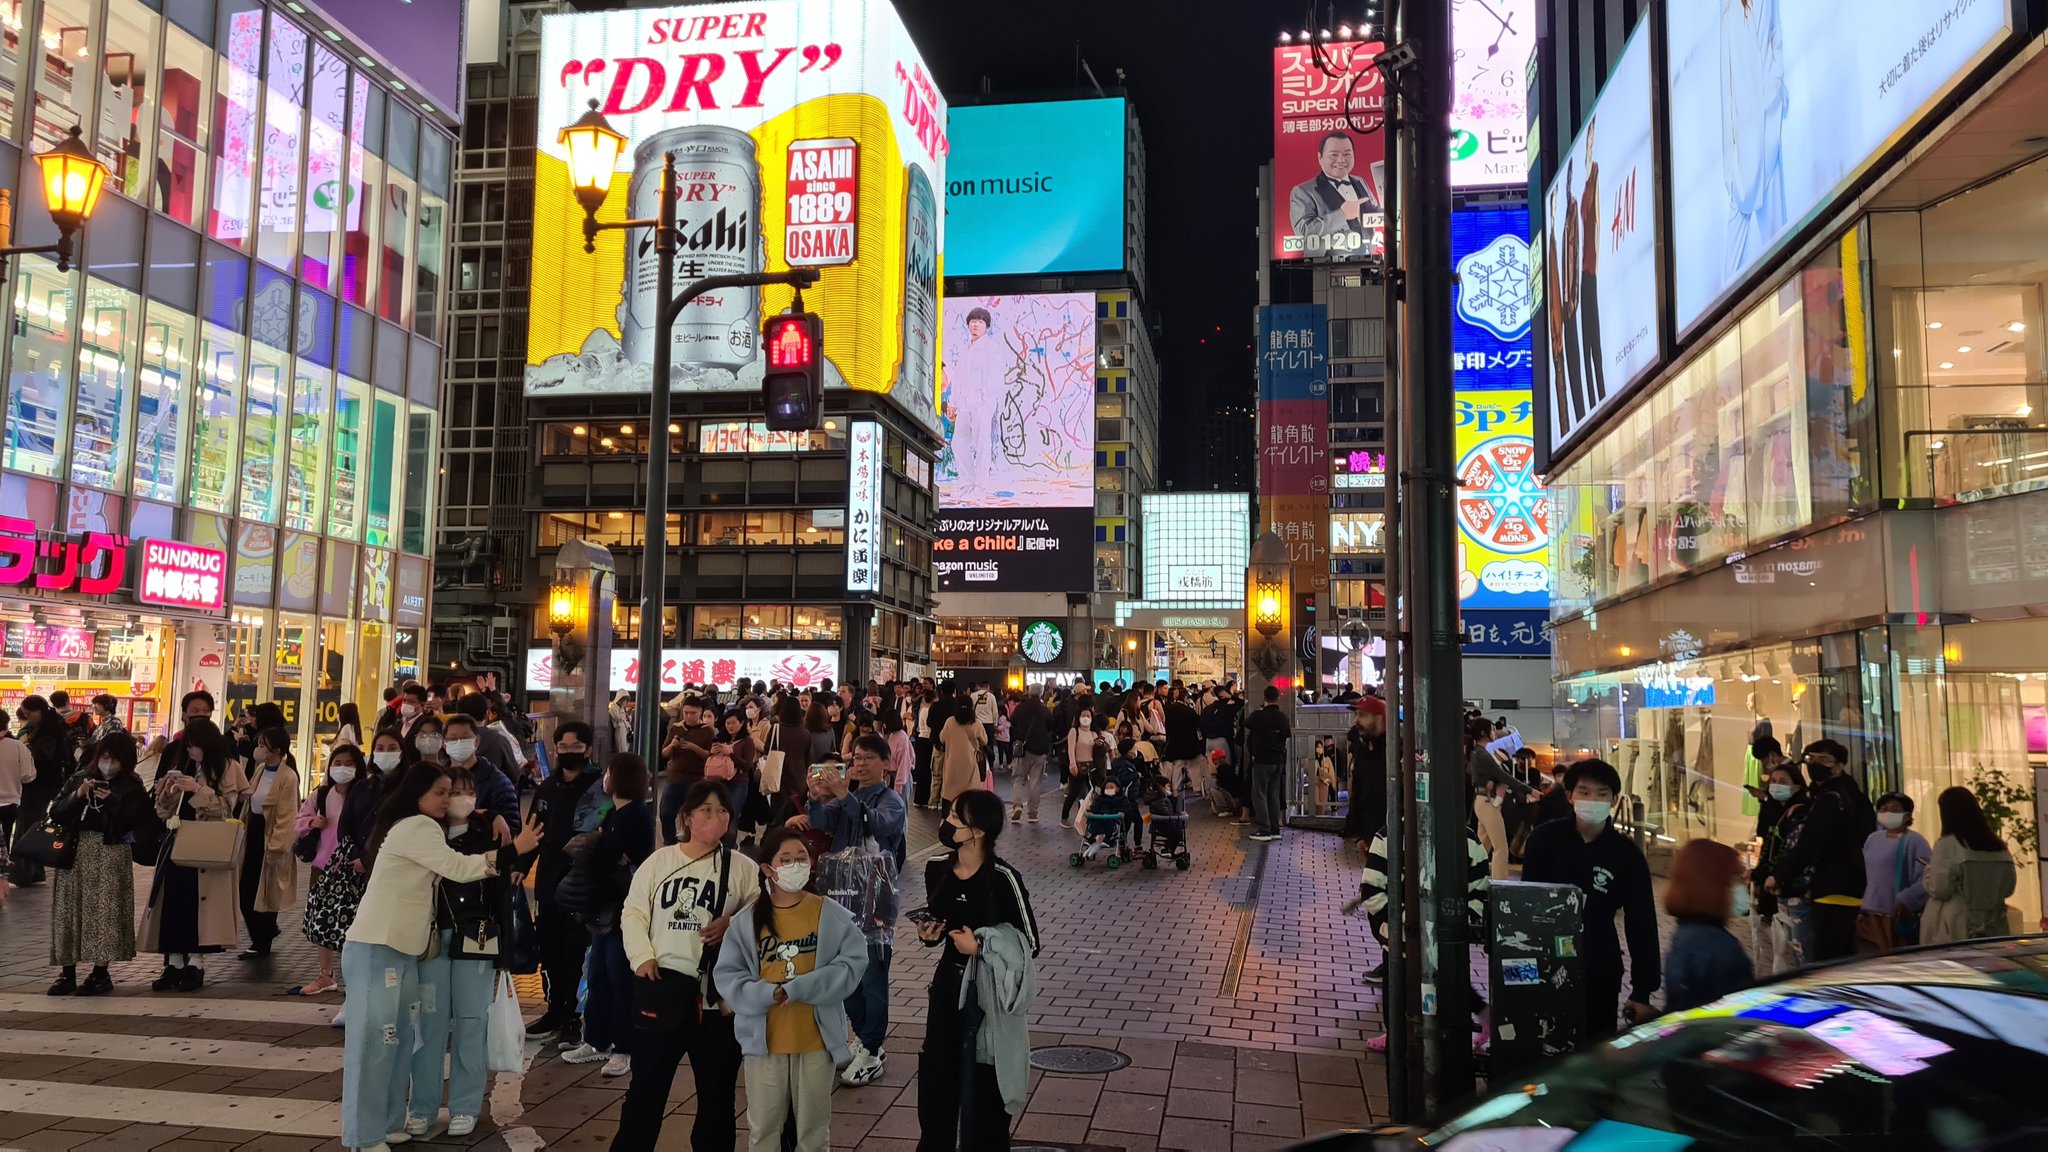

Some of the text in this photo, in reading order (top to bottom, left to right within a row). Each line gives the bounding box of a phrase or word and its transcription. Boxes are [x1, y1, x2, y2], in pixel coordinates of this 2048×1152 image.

[648, 12, 767, 45] SUPER
[1879, 0, 1976, 99] 大切に着た後はリサイク
[1282, 72, 1385, 97] ミリオン
[1500, 70, 1514, 88] 6
[1283, 98, 1337, 114] SUPER
[789, 148, 852, 181] ASAHI
[1484, 162, 1520, 175] Mar.
[677, 171, 716, 181] SUPER
[981, 171, 1053, 195] music
[806, 181, 836, 193] since
[788, 191, 852, 225] 1889
[1612, 165, 1637, 254] H&M
[788, 228, 850, 259] OSAKA
[678, 259, 705, 279] 生
[1270, 329, 1315, 349] 龍角散
[1270, 424, 1315, 444] 龍角散
[1498, 446, 1528, 455] SNOW
[958, 540, 969, 551] a
[1499, 533, 1529, 543] SNOW
[148, 545, 221, 572] SUNDRUG
[965, 558, 999, 571] music
[1177, 575, 1213, 588] 戎橋筋
[60, 633, 80, 658] 25
[660, 876, 719, 910] USA
[667, 920, 702, 932] PEANUTS
